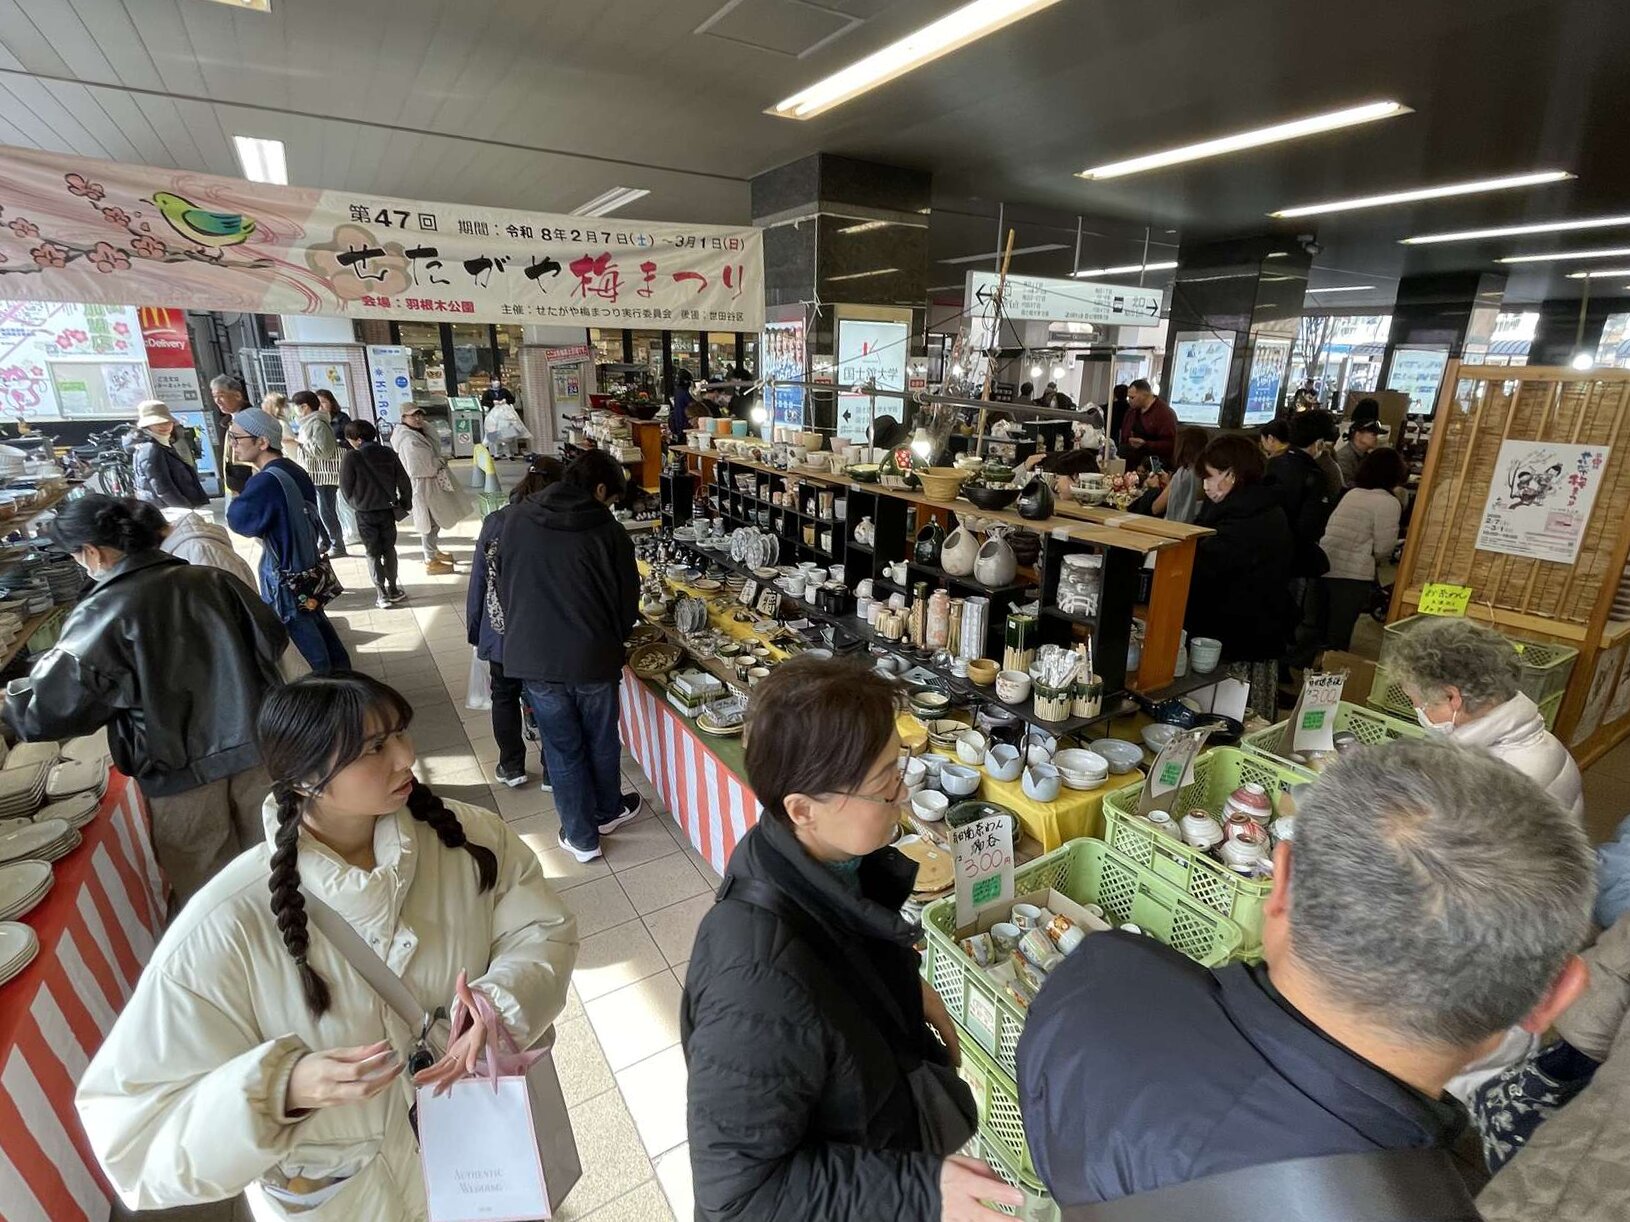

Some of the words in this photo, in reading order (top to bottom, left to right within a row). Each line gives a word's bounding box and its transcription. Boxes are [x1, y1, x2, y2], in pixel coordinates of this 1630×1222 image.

[349, 204, 438, 232] 第47回
[336, 244, 743, 304] せたがや梅まつり
[361, 295, 475, 314] 会場：羽根木公園
